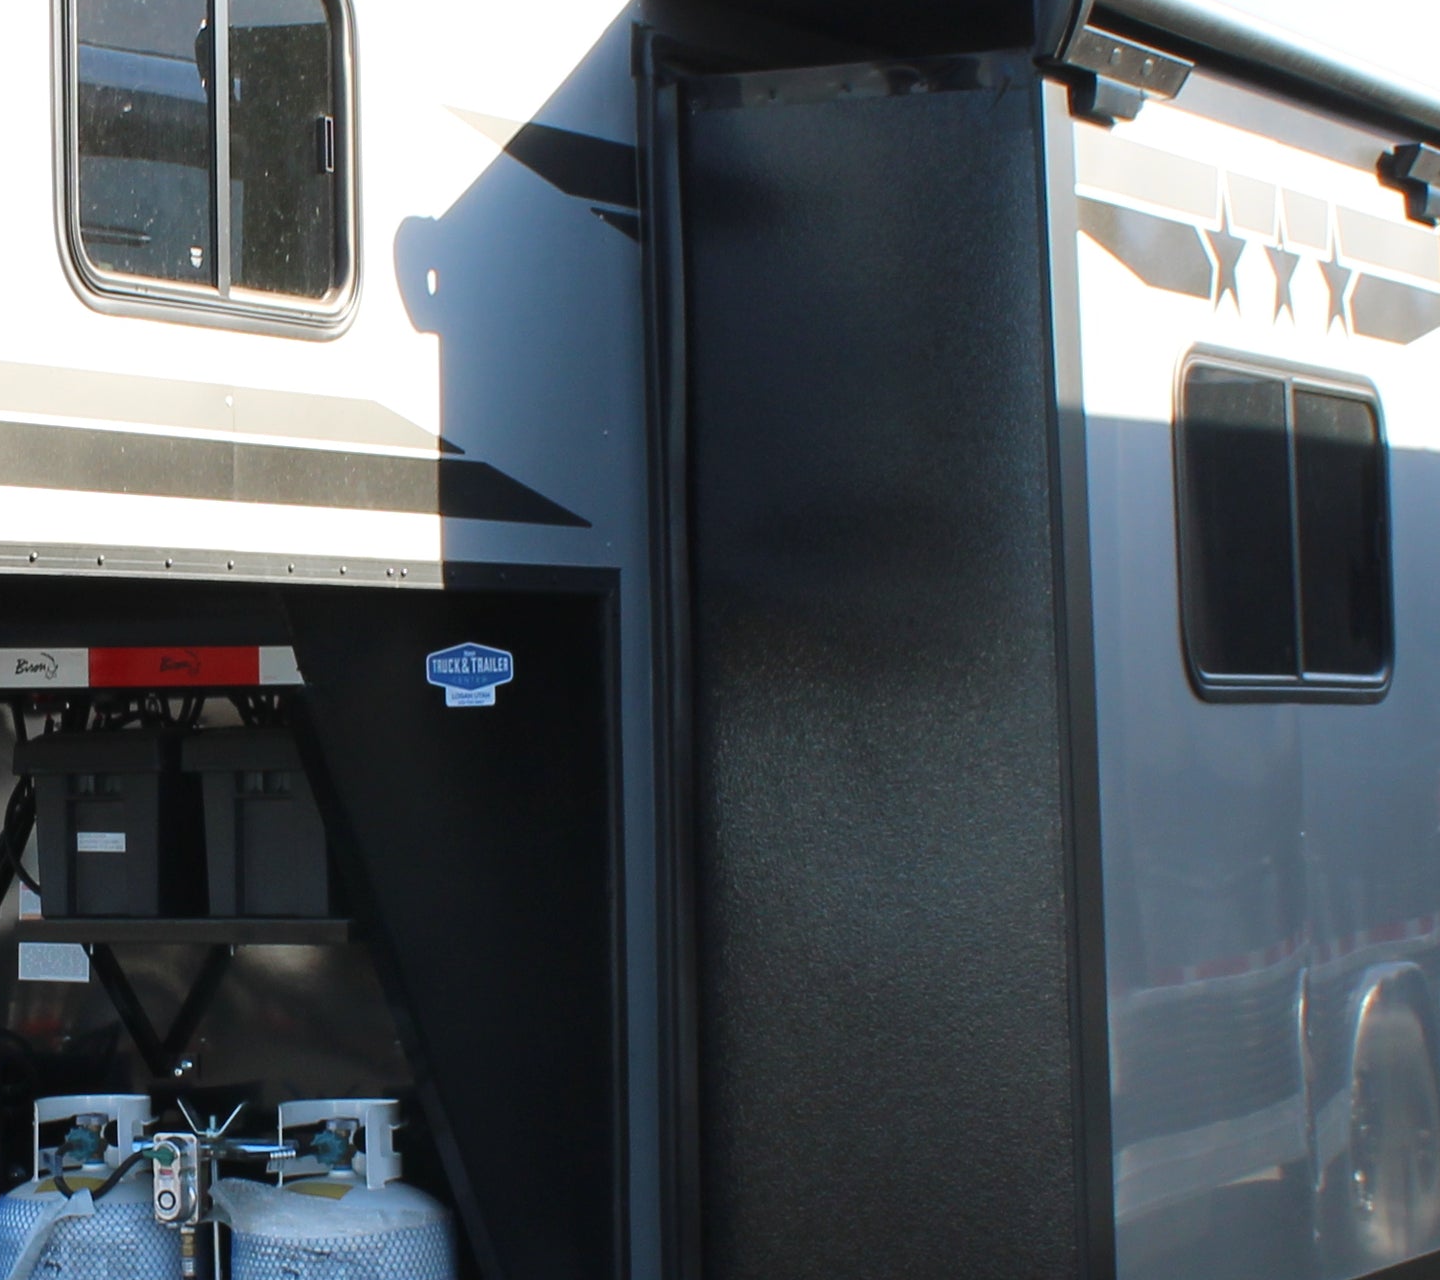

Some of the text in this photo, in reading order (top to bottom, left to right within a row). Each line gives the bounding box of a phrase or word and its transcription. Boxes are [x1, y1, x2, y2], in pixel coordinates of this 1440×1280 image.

[15, 658, 47, 675] Bison
[432, 656, 509, 674] TRUCK & TRAILER
